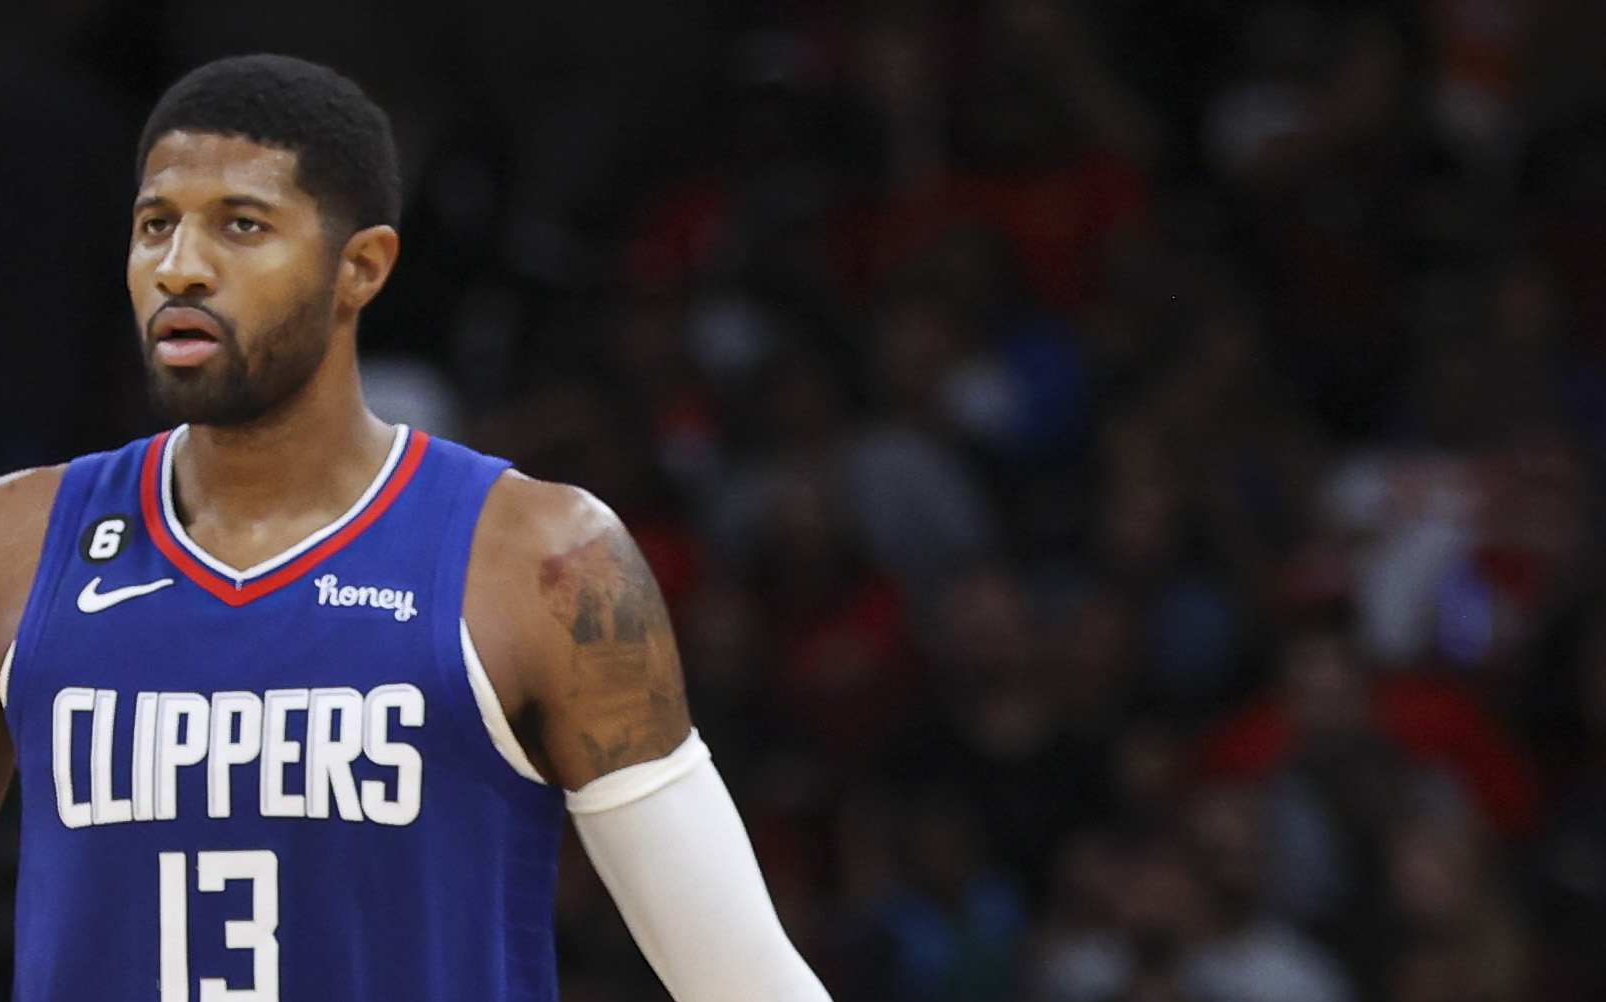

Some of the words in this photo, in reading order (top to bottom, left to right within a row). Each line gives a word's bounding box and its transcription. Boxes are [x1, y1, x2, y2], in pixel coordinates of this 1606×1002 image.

[88, 518, 126, 560] 6
[313, 573, 419, 623] honey
[52, 682, 426, 830] CLIPPERS
